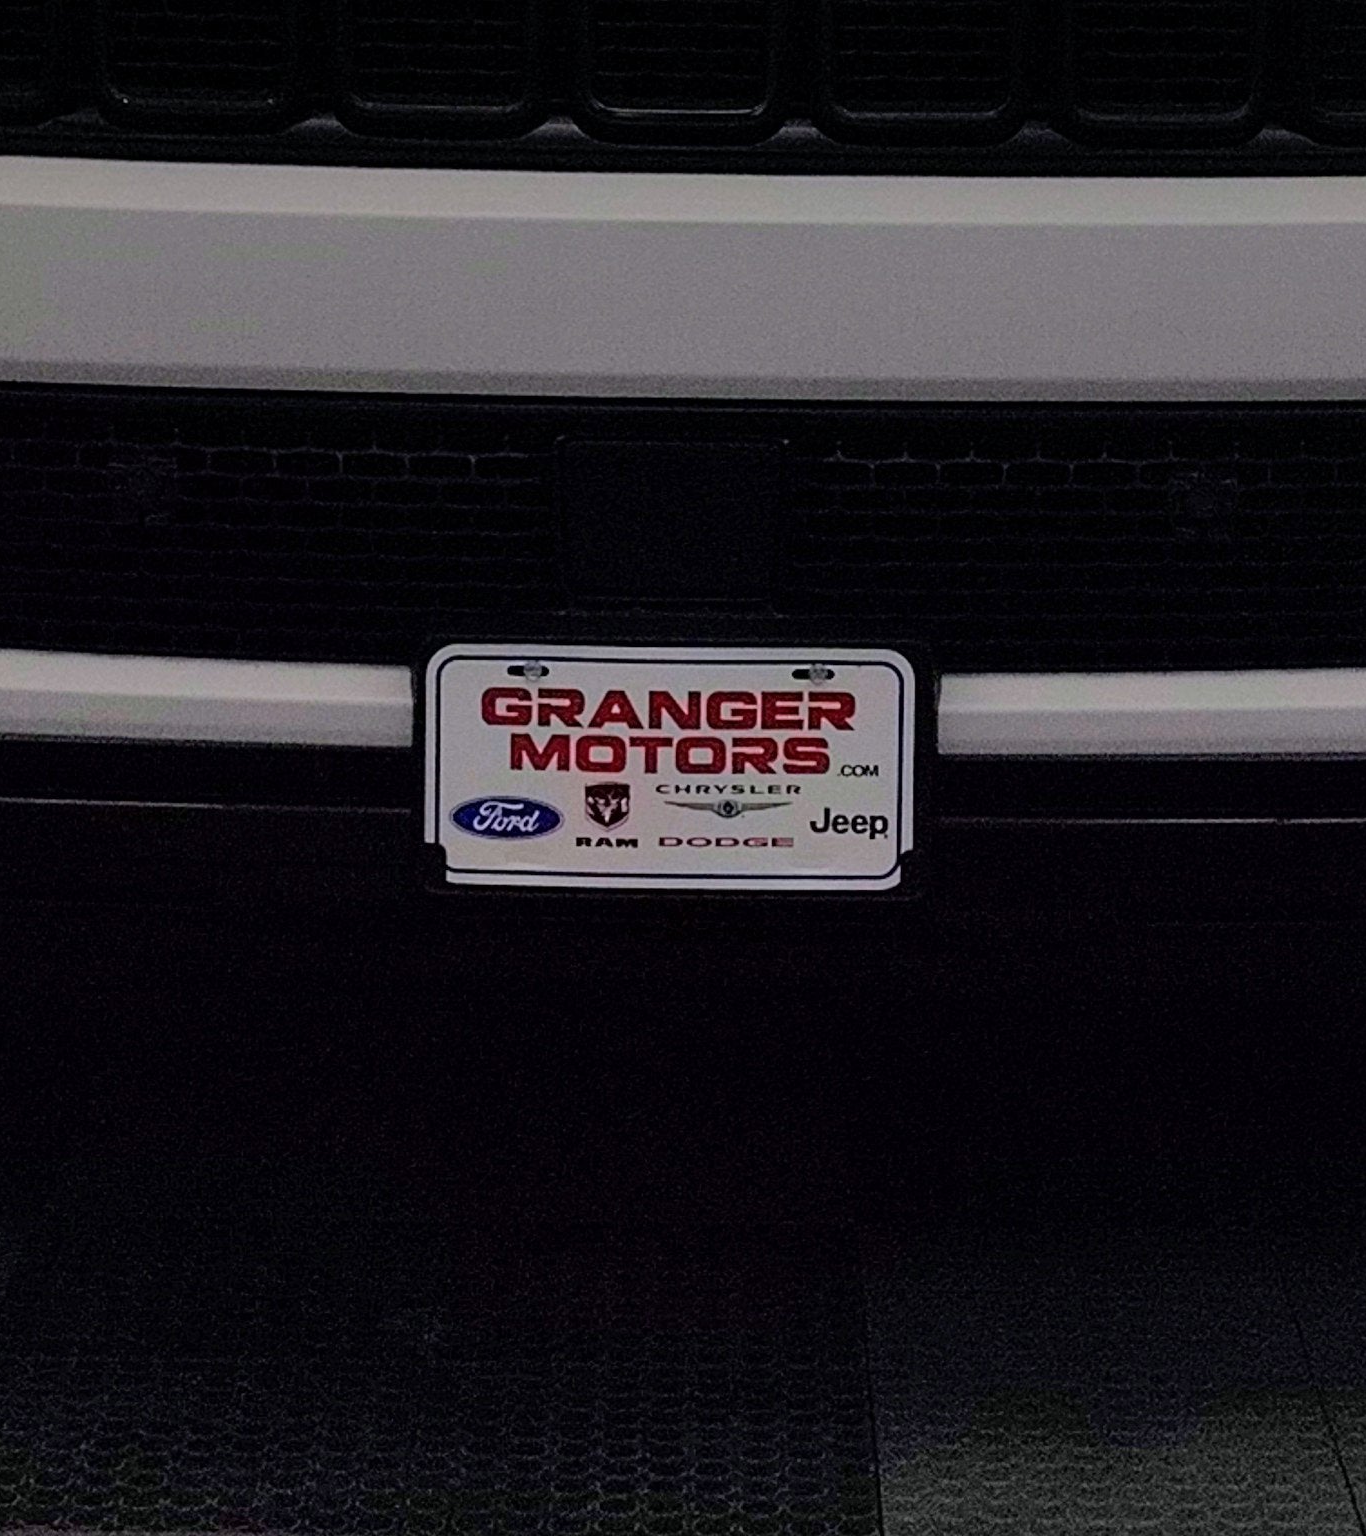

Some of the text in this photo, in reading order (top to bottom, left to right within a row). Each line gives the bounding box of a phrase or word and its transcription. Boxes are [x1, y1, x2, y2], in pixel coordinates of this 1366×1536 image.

[481, 687, 856, 731] GRANGER
[510, 733, 879, 777] MOTORS .COM
[655, 784, 802, 795] CHRYSLER
[473, 801, 540, 832] Ford
[810, 808, 889, 839] Jeep
[576, 837, 638, 848] RAM
[658, 837, 794, 848] DODGE
